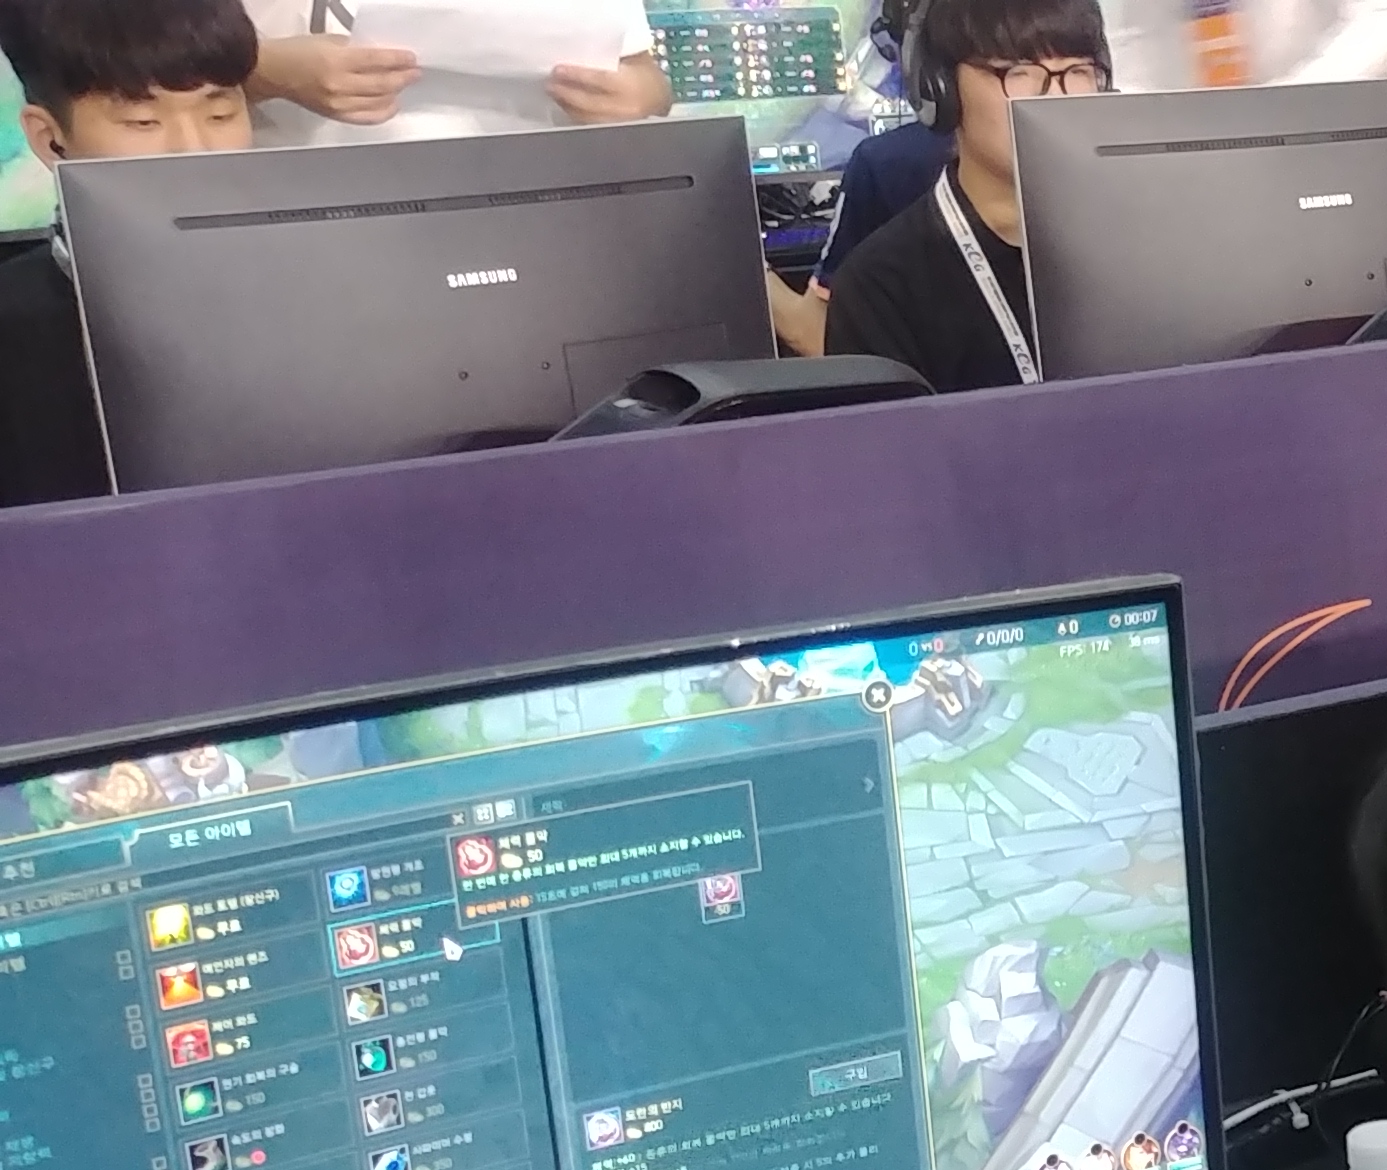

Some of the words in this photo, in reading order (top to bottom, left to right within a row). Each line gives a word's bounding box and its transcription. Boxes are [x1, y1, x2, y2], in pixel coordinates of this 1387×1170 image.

[447, 268, 517, 288] SAMSUNG
[1124, 609, 1158, 626] 00:07
[987, 629, 1024, 645] 0/0/0
[168, 830, 200, 848] 모든
[205, 820, 251, 842] 아이템
[235, 1035, 251, 1050] 75
